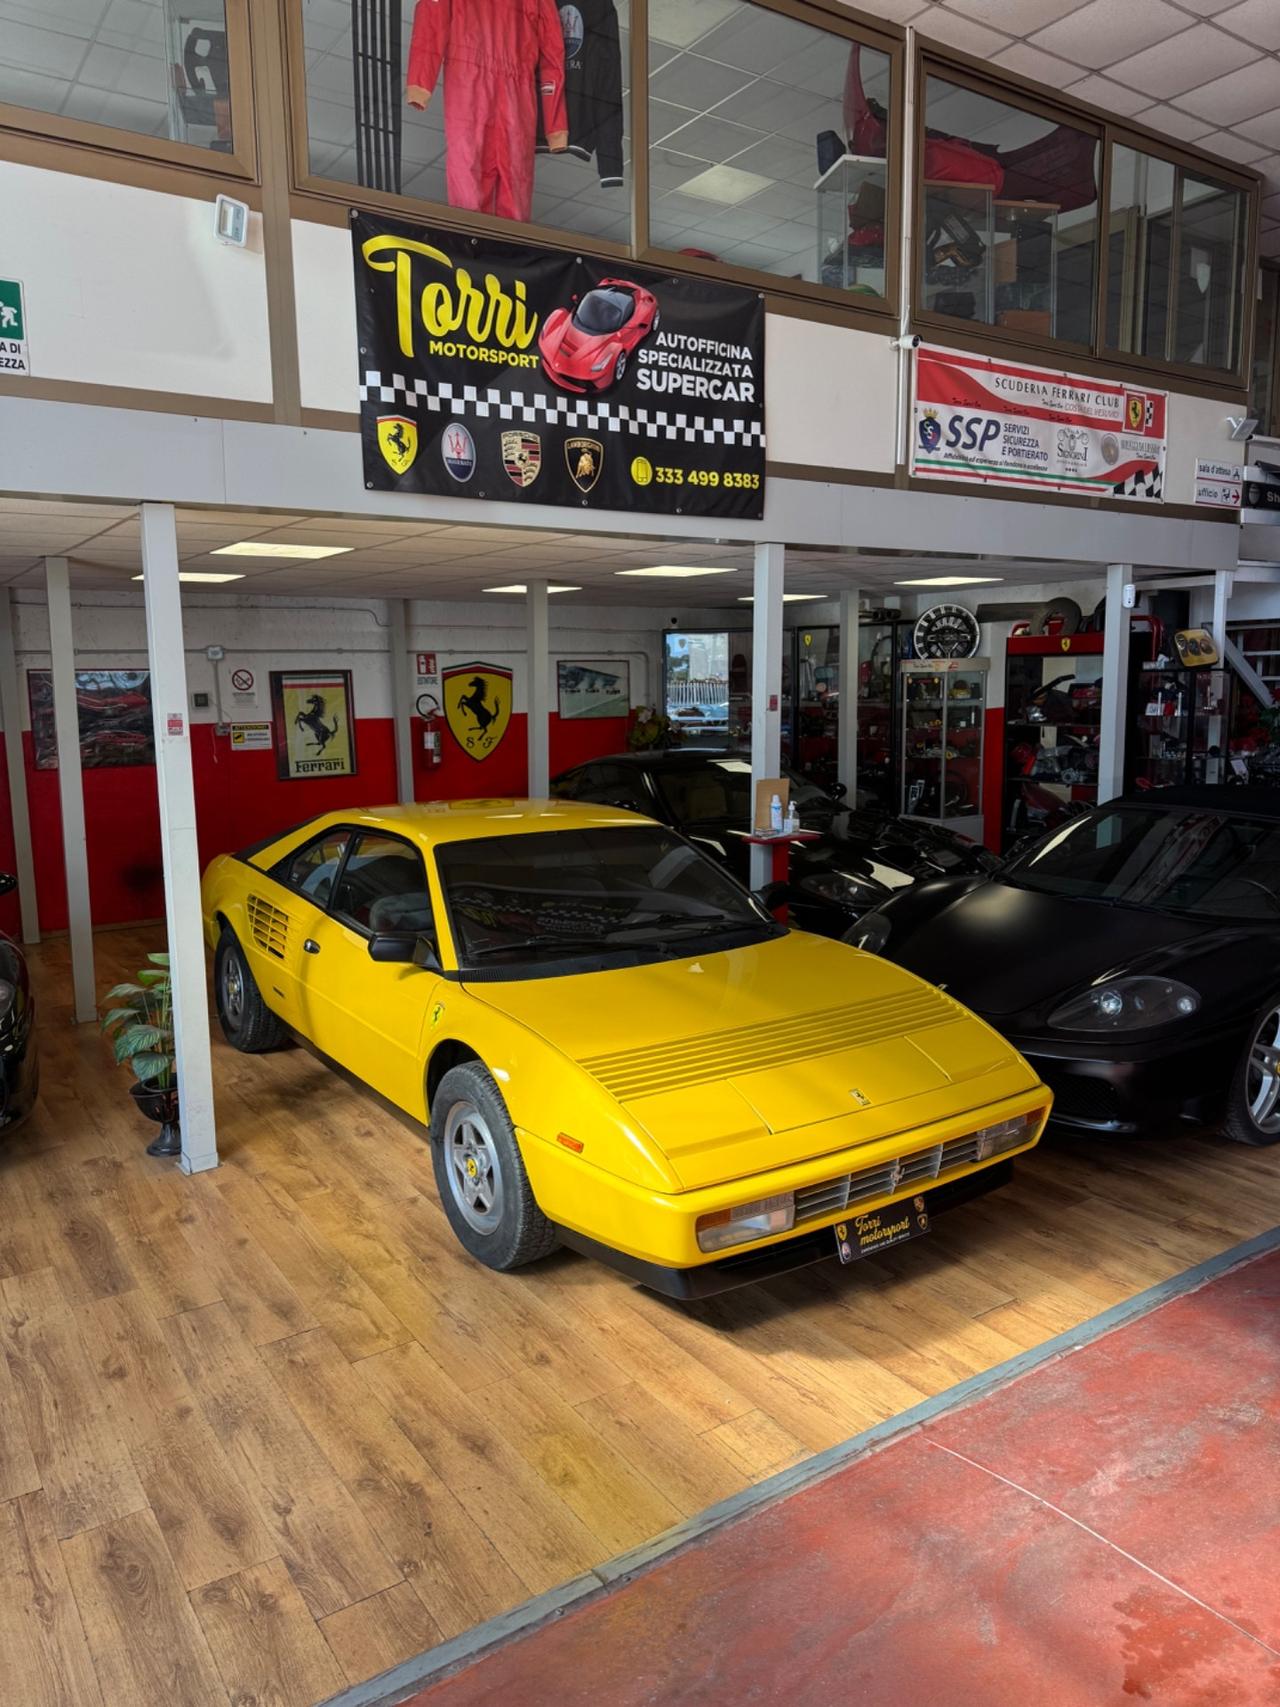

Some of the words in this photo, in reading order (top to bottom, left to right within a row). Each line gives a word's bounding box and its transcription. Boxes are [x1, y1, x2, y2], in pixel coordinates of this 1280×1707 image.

[362, 234, 538, 358] Torri
[10, 342, 21, 354] DI
[429, 340, 540, 369] MOTORSPORT
[655, 331, 753, 361] AUTOFFICINA
[637, 348, 754, 379] SPECIALIZZATA
[636, 368, 755, 403] SUPERCAR
[995, 377, 1049, 397] SCUDERIA
[1052, 386, 1091, 403] FERRARI
[1095, 395, 1120, 408] CLUB
[946, 414, 1001, 451] SSP
[1003, 422, 1030, 435] SERVIZI
[1003, 434, 1040, 449] SICUREZZA
[1002, 447, 1007, 456] E
[1008, 448, 1049, 462] PORTIERATO
[655, 467, 684, 485] 333
[687, 470, 720, 487] 499
[723, 472, 760, 489] 8383
[1199, 464, 1210, 473] sala
[1198, 488, 1218, 498] ufficio
[466, 736, 475, 748] S
[295, 758, 345, 773] Ferrari
[855, 1215, 881, 1235] Torri
[860, 1216, 911, 1246] motorsport
